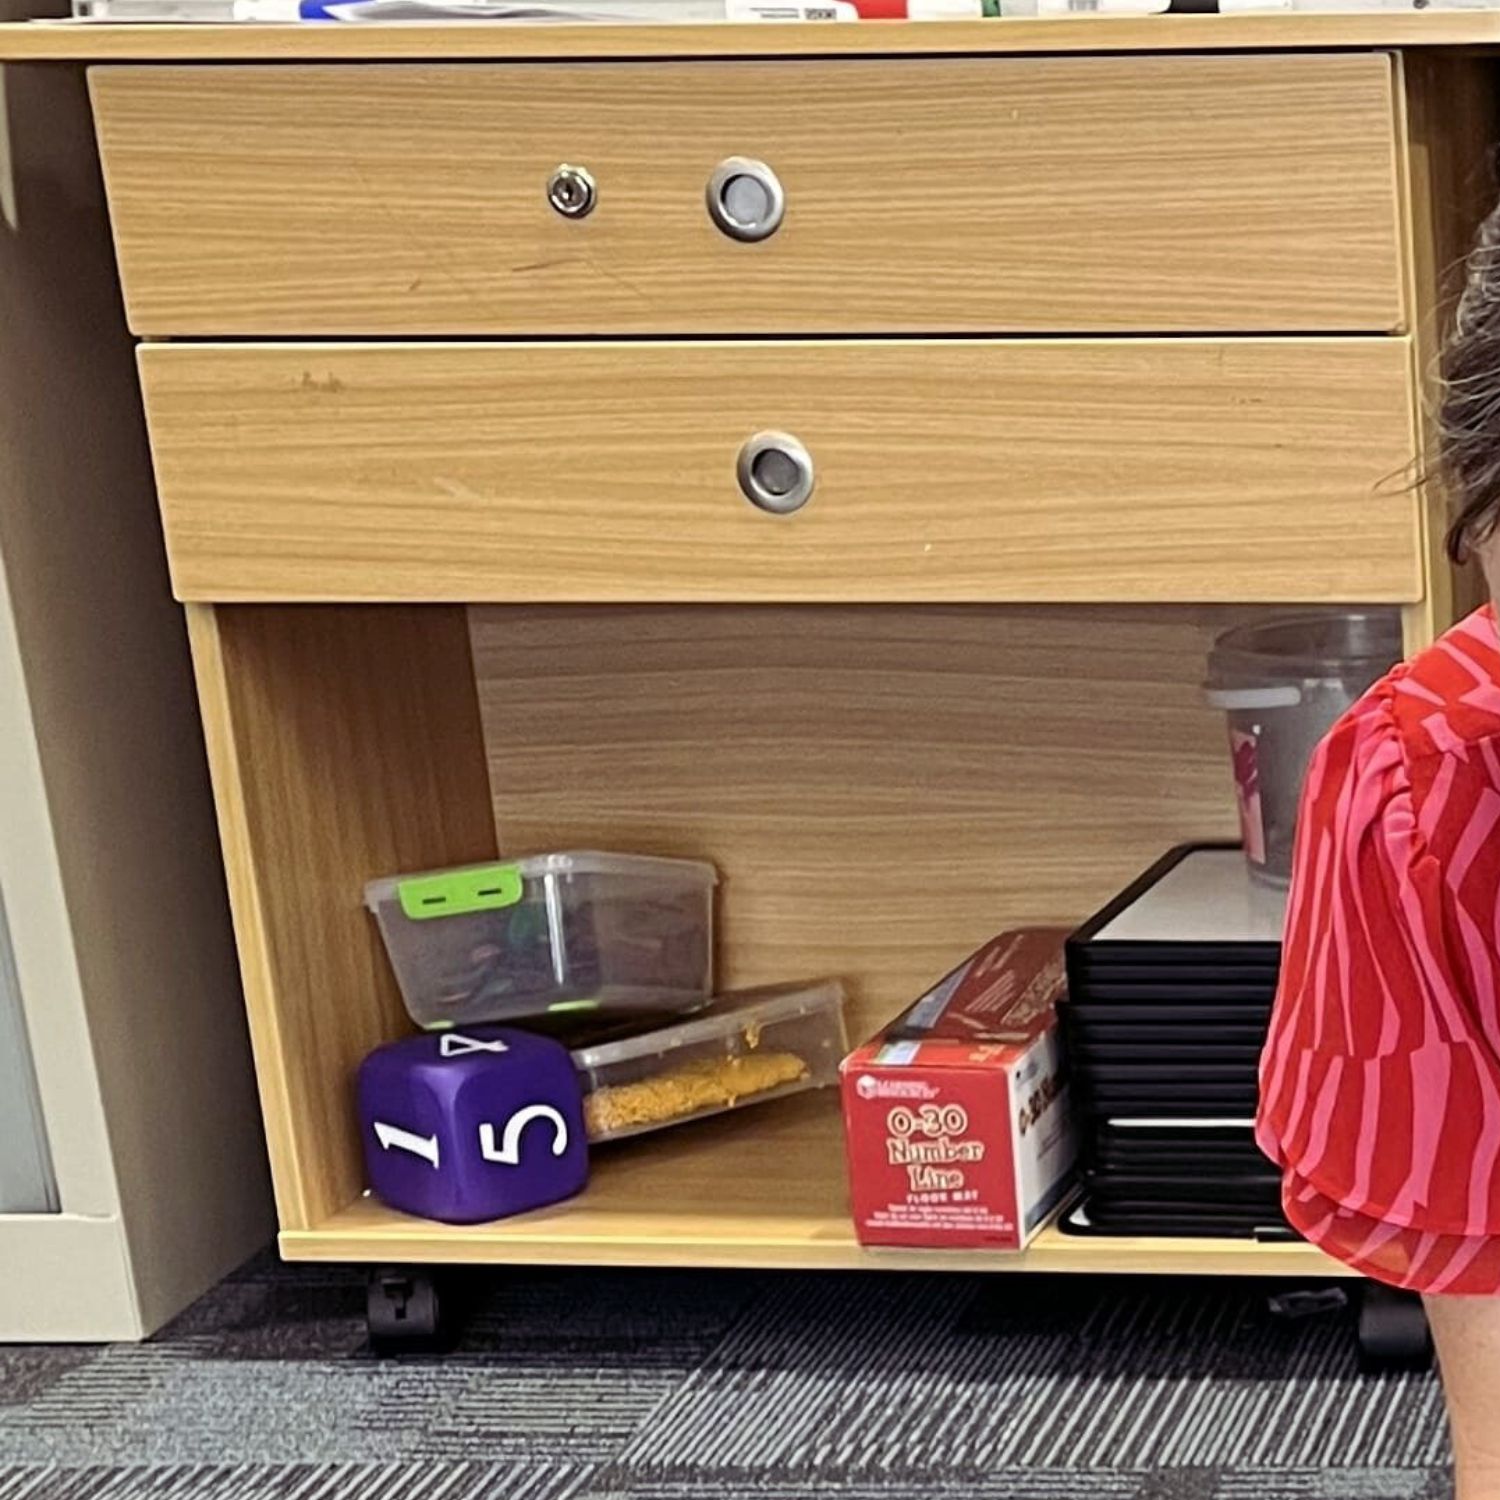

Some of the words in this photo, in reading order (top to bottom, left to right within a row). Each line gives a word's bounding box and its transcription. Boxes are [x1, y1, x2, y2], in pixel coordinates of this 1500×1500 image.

[440, 1032, 509, 1057] 4
[478, 1104, 567, 1164] 5
[887, 1104, 968, 1137] 0-30
[373, 1121, 440, 1170] 1
[886, 1136, 985, 1164] Number
[907, 1165, 964, 1191] Line
